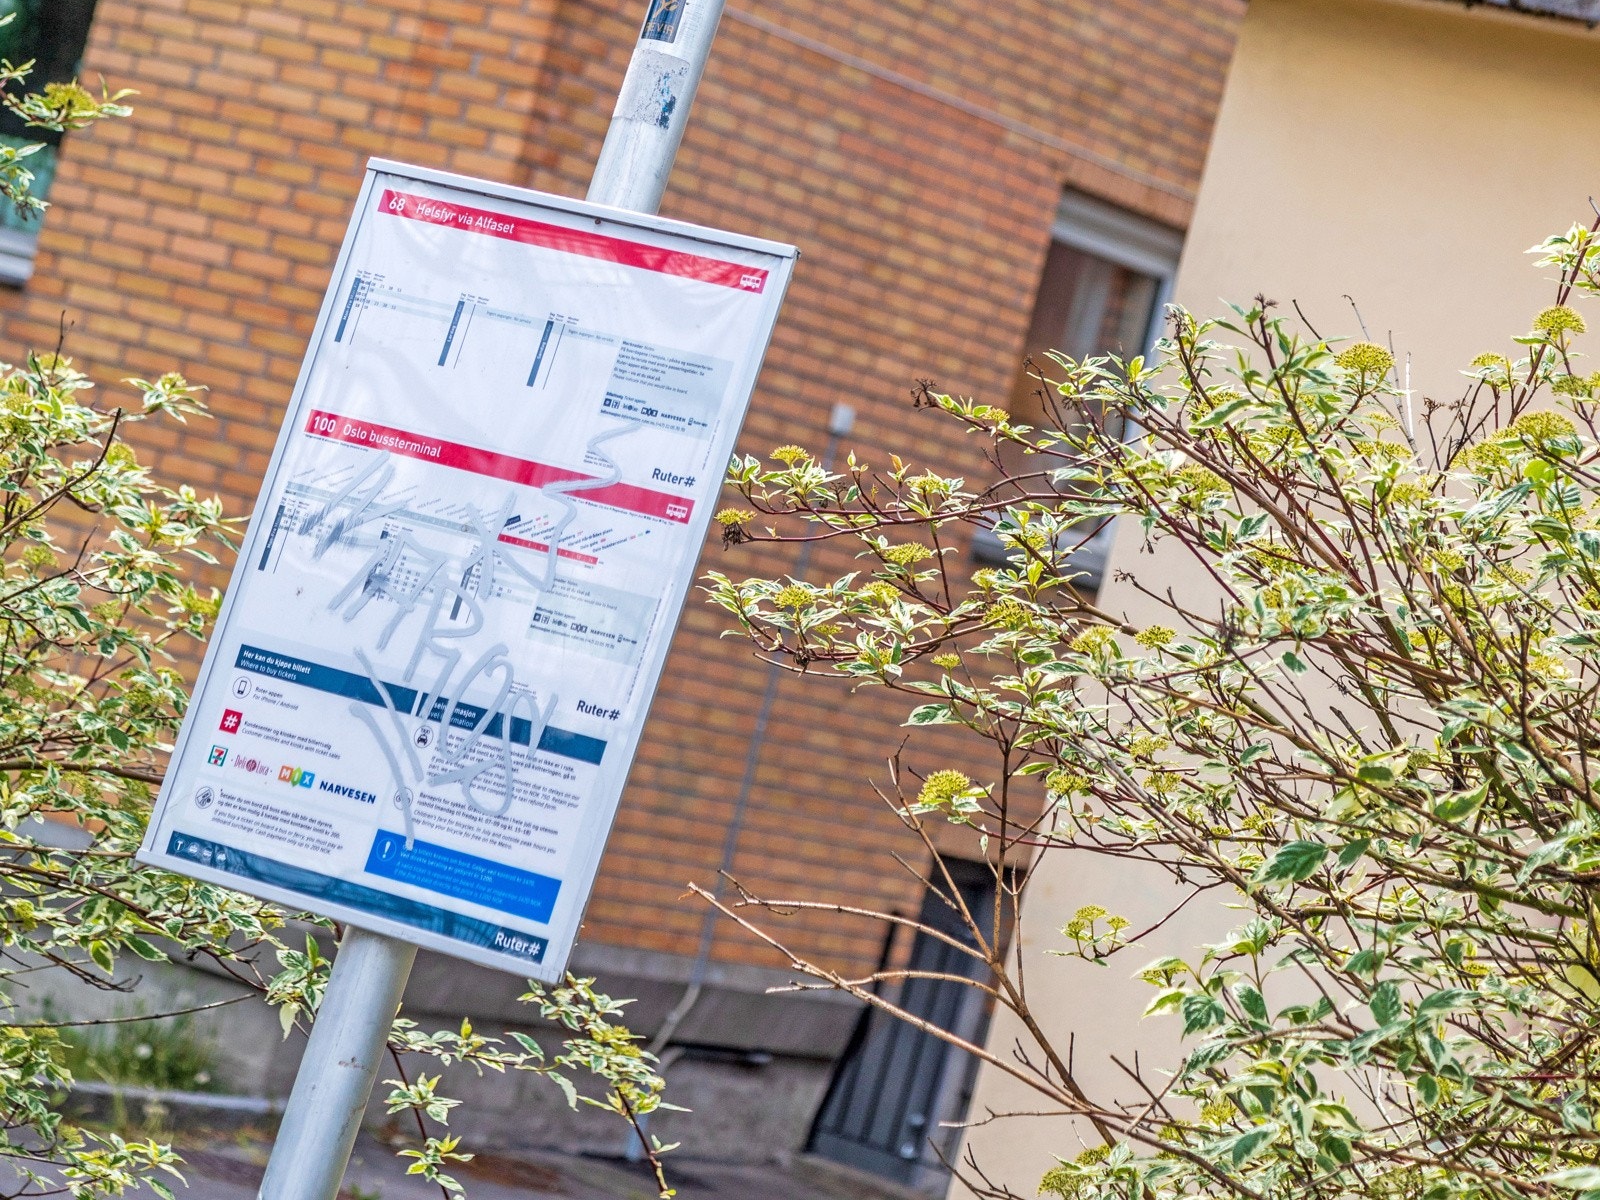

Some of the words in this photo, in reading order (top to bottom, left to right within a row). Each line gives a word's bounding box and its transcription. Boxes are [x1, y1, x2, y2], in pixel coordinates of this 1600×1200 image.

[387, 195, 407, 211] 68
[415, 203, 456, 222] Helsfyr
[456, 211, 474, 225] via
[474, 215, 515, 233] Alfaset
[311, 415, 337, 433] 100
[341, 423, 368, 440] Oslo
[368, 429, 442, 458] bussterminal
[651, 468, 696, 488] Ruter#
[239, 659, 259, 670] Where
[258, 664, 266, 672] to
[265, 666, 277, 677] buy
[277, 669, 297, 680] tickets
[242, 650, 254, 658] Her
[254, 653, 266, 662] kan
[265, 656, 274, 664] du
[274, 658, 291, 670] kjøpe
[291, 663, 311, 674] billett
[576, 699, 621, 721] Ruter#
[280, 767, 312, 785] MIX
[318, 779, 376, 804] NARVESEN
[494, 931, 541, 957] Ruter#
